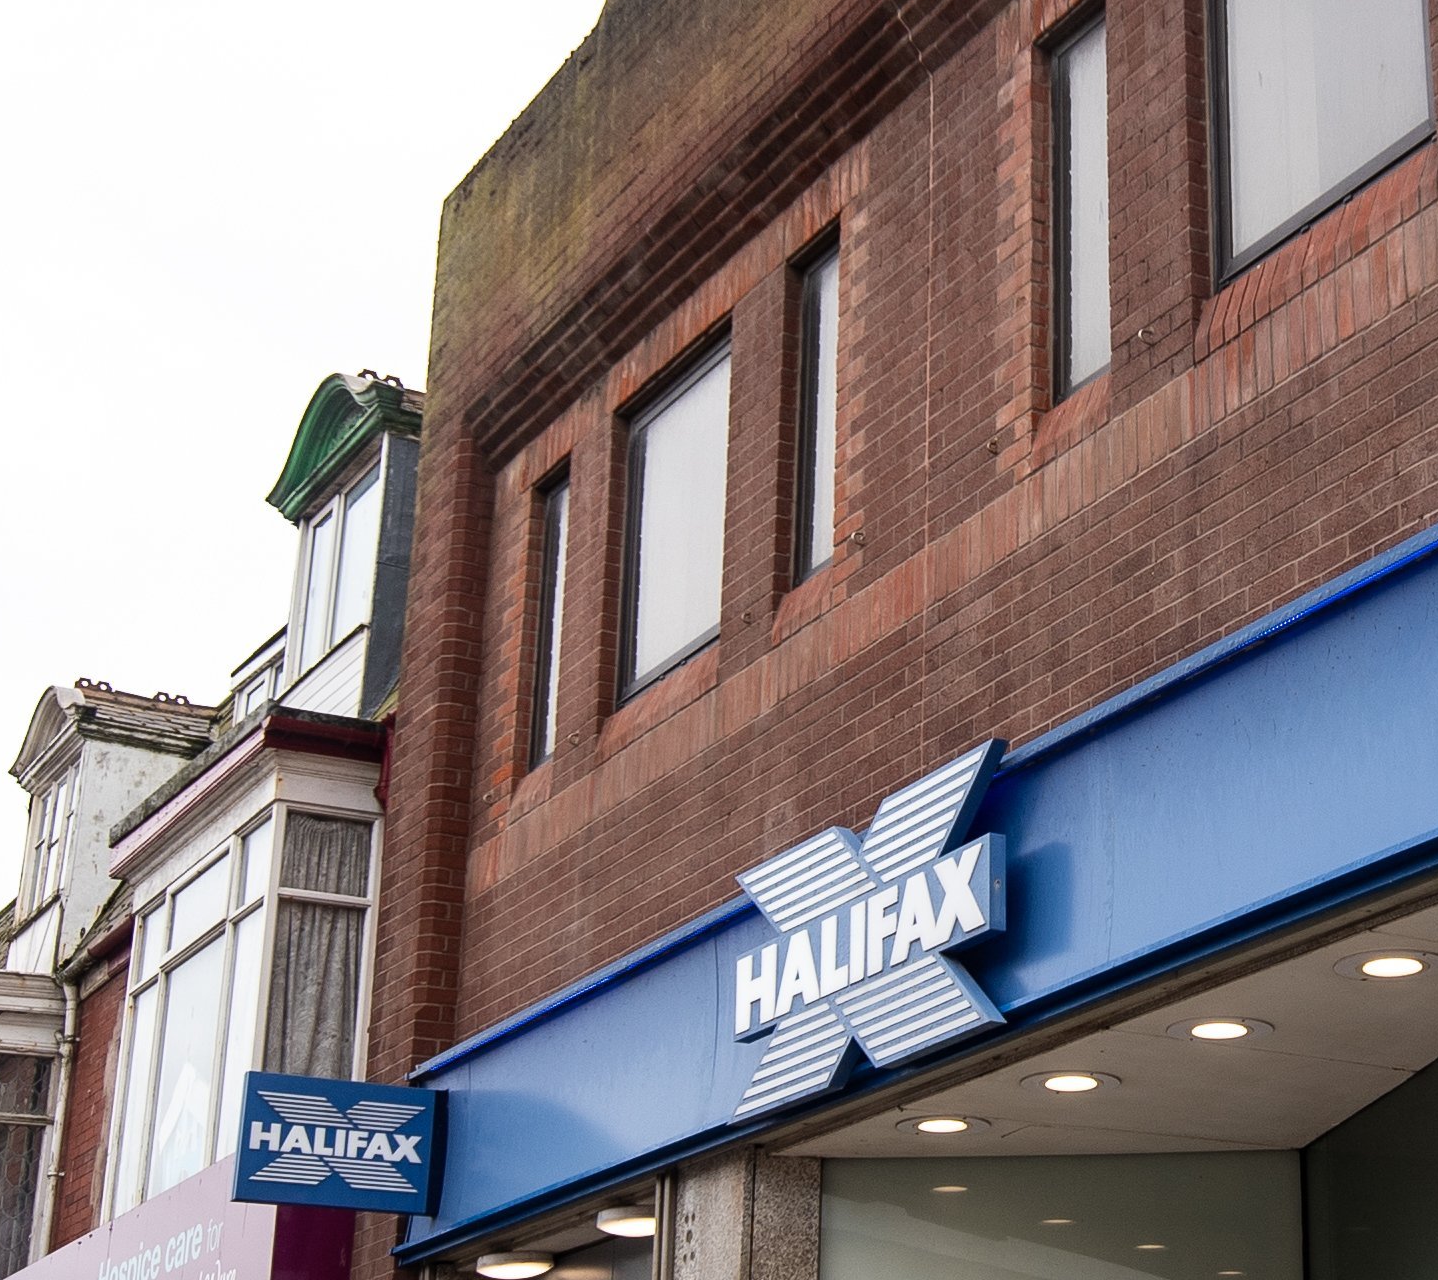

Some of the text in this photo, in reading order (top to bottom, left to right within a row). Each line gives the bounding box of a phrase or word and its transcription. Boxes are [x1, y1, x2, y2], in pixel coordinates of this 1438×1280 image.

[735, 843, 987, 1034] HALIFAX
[249, 1121, 422, 1164] HALIFAX
[165, 1223, 203, 1273] care
[206, 1218, 224, 1253] for
